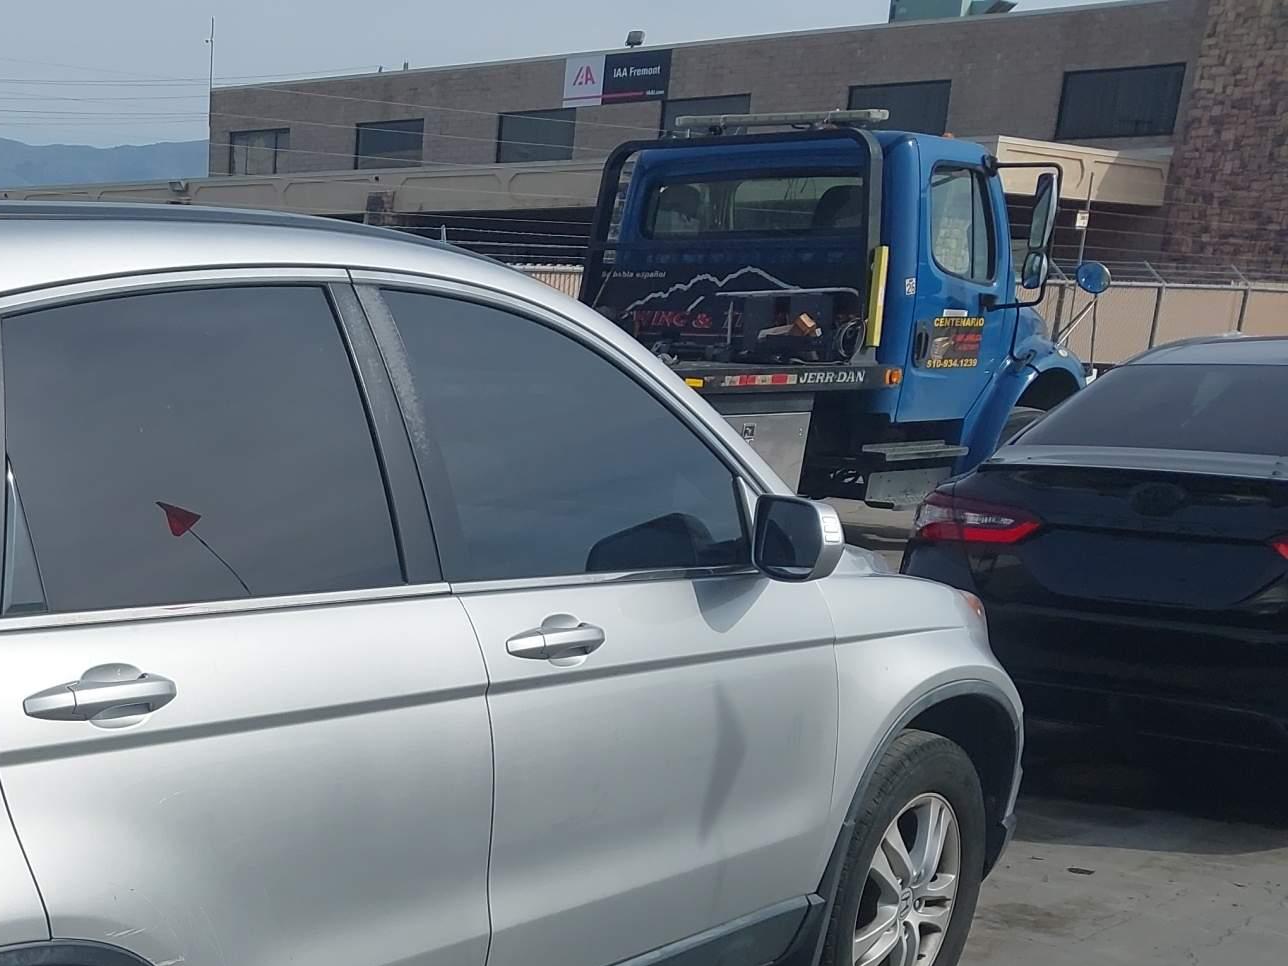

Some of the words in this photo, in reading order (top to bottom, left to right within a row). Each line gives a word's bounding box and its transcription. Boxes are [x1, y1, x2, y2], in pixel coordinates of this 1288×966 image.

[613, 67, 628, 78] IAA
[629, 66, 661, 77] Fremont
[934, 318, 984, 327] CENTENARIO
